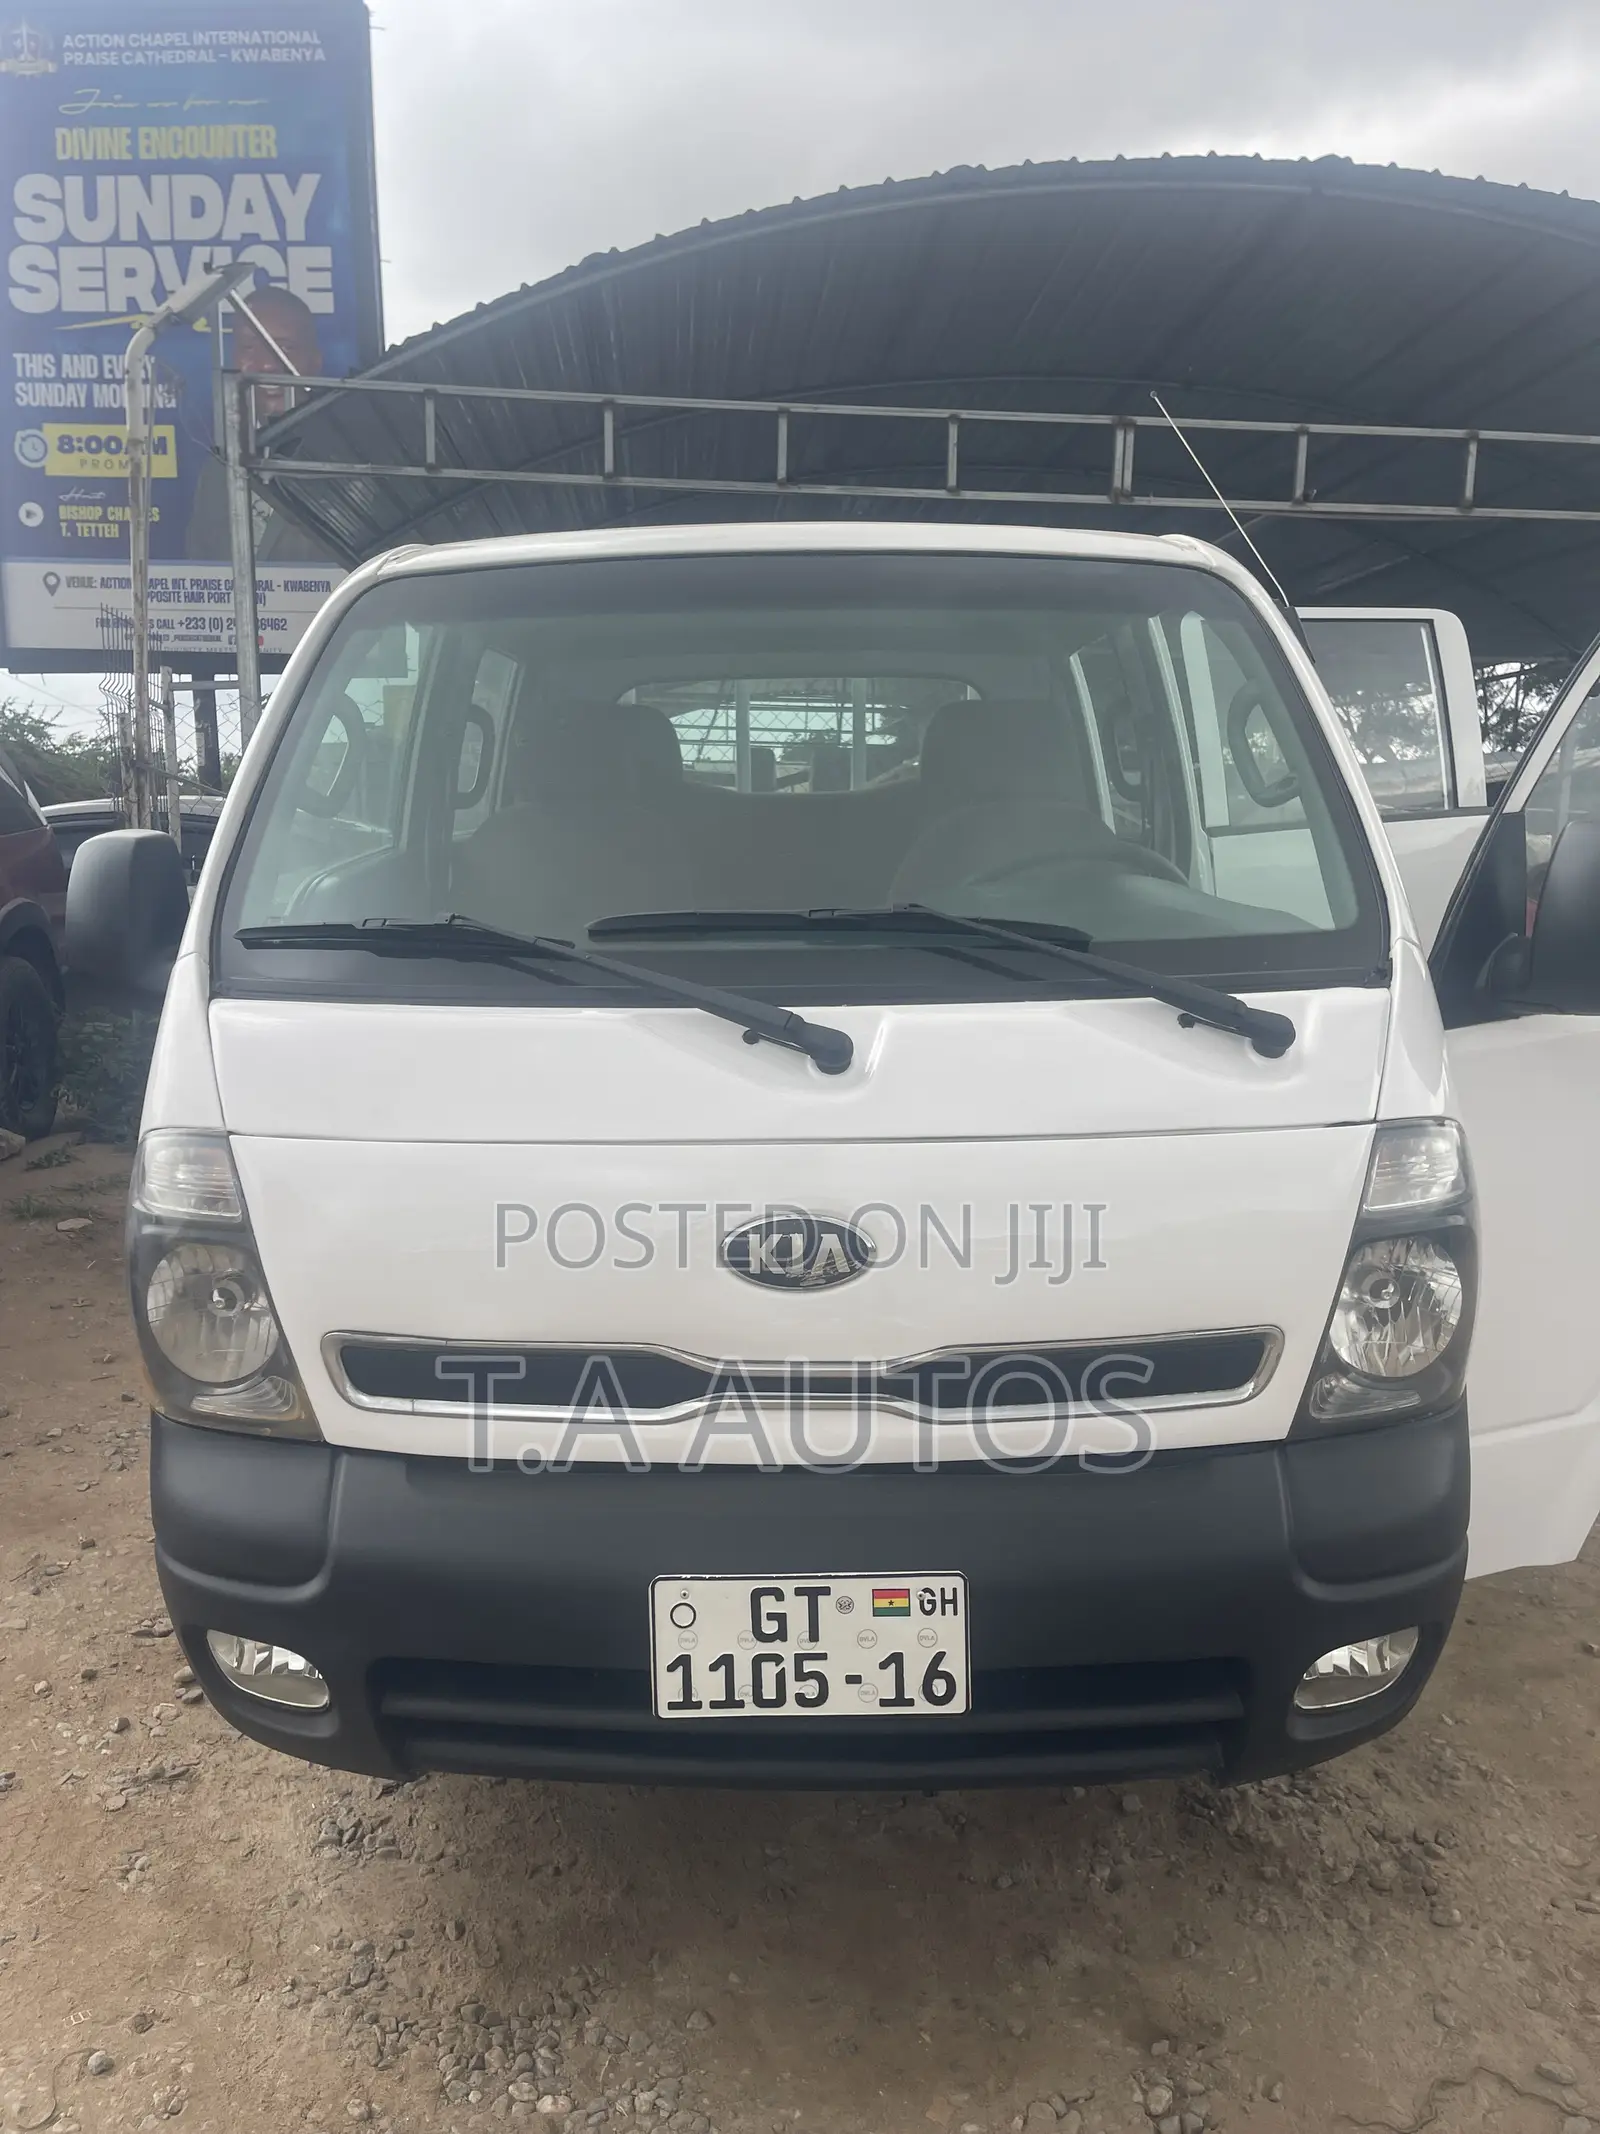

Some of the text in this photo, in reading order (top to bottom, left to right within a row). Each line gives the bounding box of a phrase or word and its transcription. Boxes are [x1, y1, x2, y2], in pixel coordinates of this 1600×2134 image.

[63, 30, 321, 49] ACTION CHAPEL INTERNATIONAL
[63, 51, 119, 66] PRAISE
[124, 50, 217, 65] CATHEDRAL
[231, 48, 326, 63] KWABENYA
[55, 124, 278, 160] DIVINE ENCOUNTER
[13, 173, 322, 243] SUNDAY
[13, 353, 56, 379] THIS
[61, 354, 99, 379] AND
[14, 382, 88, 408] SUNDAY
[58, 505, 103, 520] BISHOP
[60, 522, 119, 538] T. TETTEH
[65, 576, 98, 588] VENUE:
[190, 579, 223, 591] PRAISE
[283, 580, 332, 593] KWABENYA
[207, 592, 231, 604] PORT
[157, 618, 175, 629] CALL
[177, 617, 206, 630] +233
[209, 617, 223, 633] (0)
[747, 1233, 850, 1274] KIA
[750, 1586, 959, 1643] GT GH
